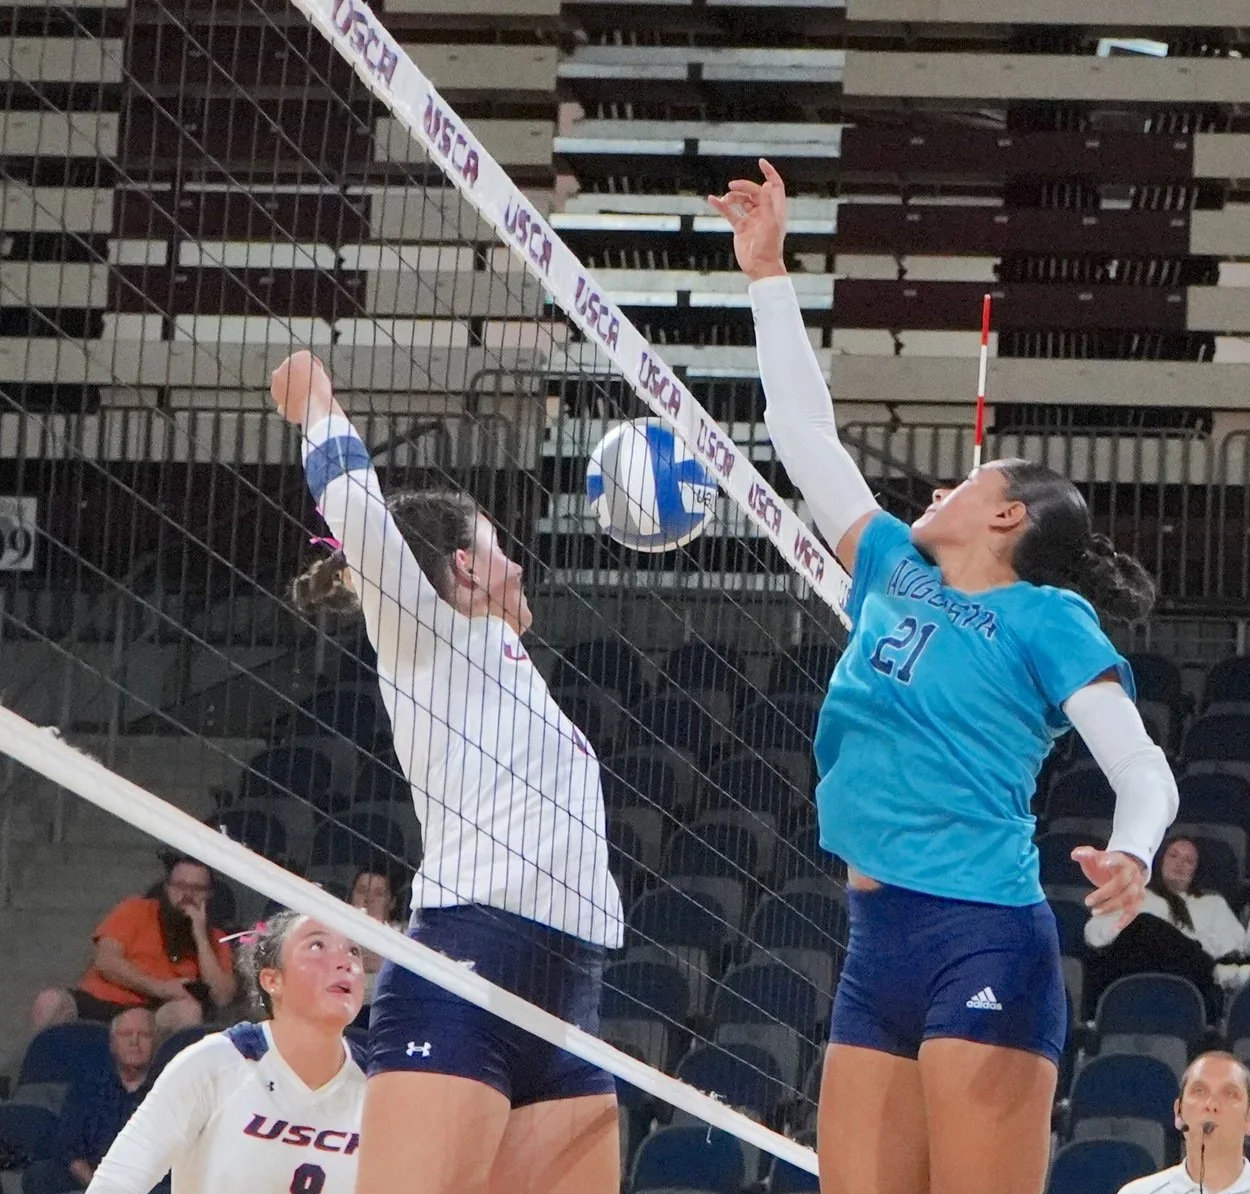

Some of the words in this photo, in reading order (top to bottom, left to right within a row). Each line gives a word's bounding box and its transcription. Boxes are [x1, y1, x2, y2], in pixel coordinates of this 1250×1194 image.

[332, 0, 398, 91] USCA
[423, 93, 479, 188] USCA
[505, 197, 552, 276] USCA
[574, 276, 620, 352] USCA
[638, 352, 681, 419] USCA
[696, 418, 735, 479] USCA
[748, 481, 782, 537] USCA
[869, 617, 938, 685] 21
